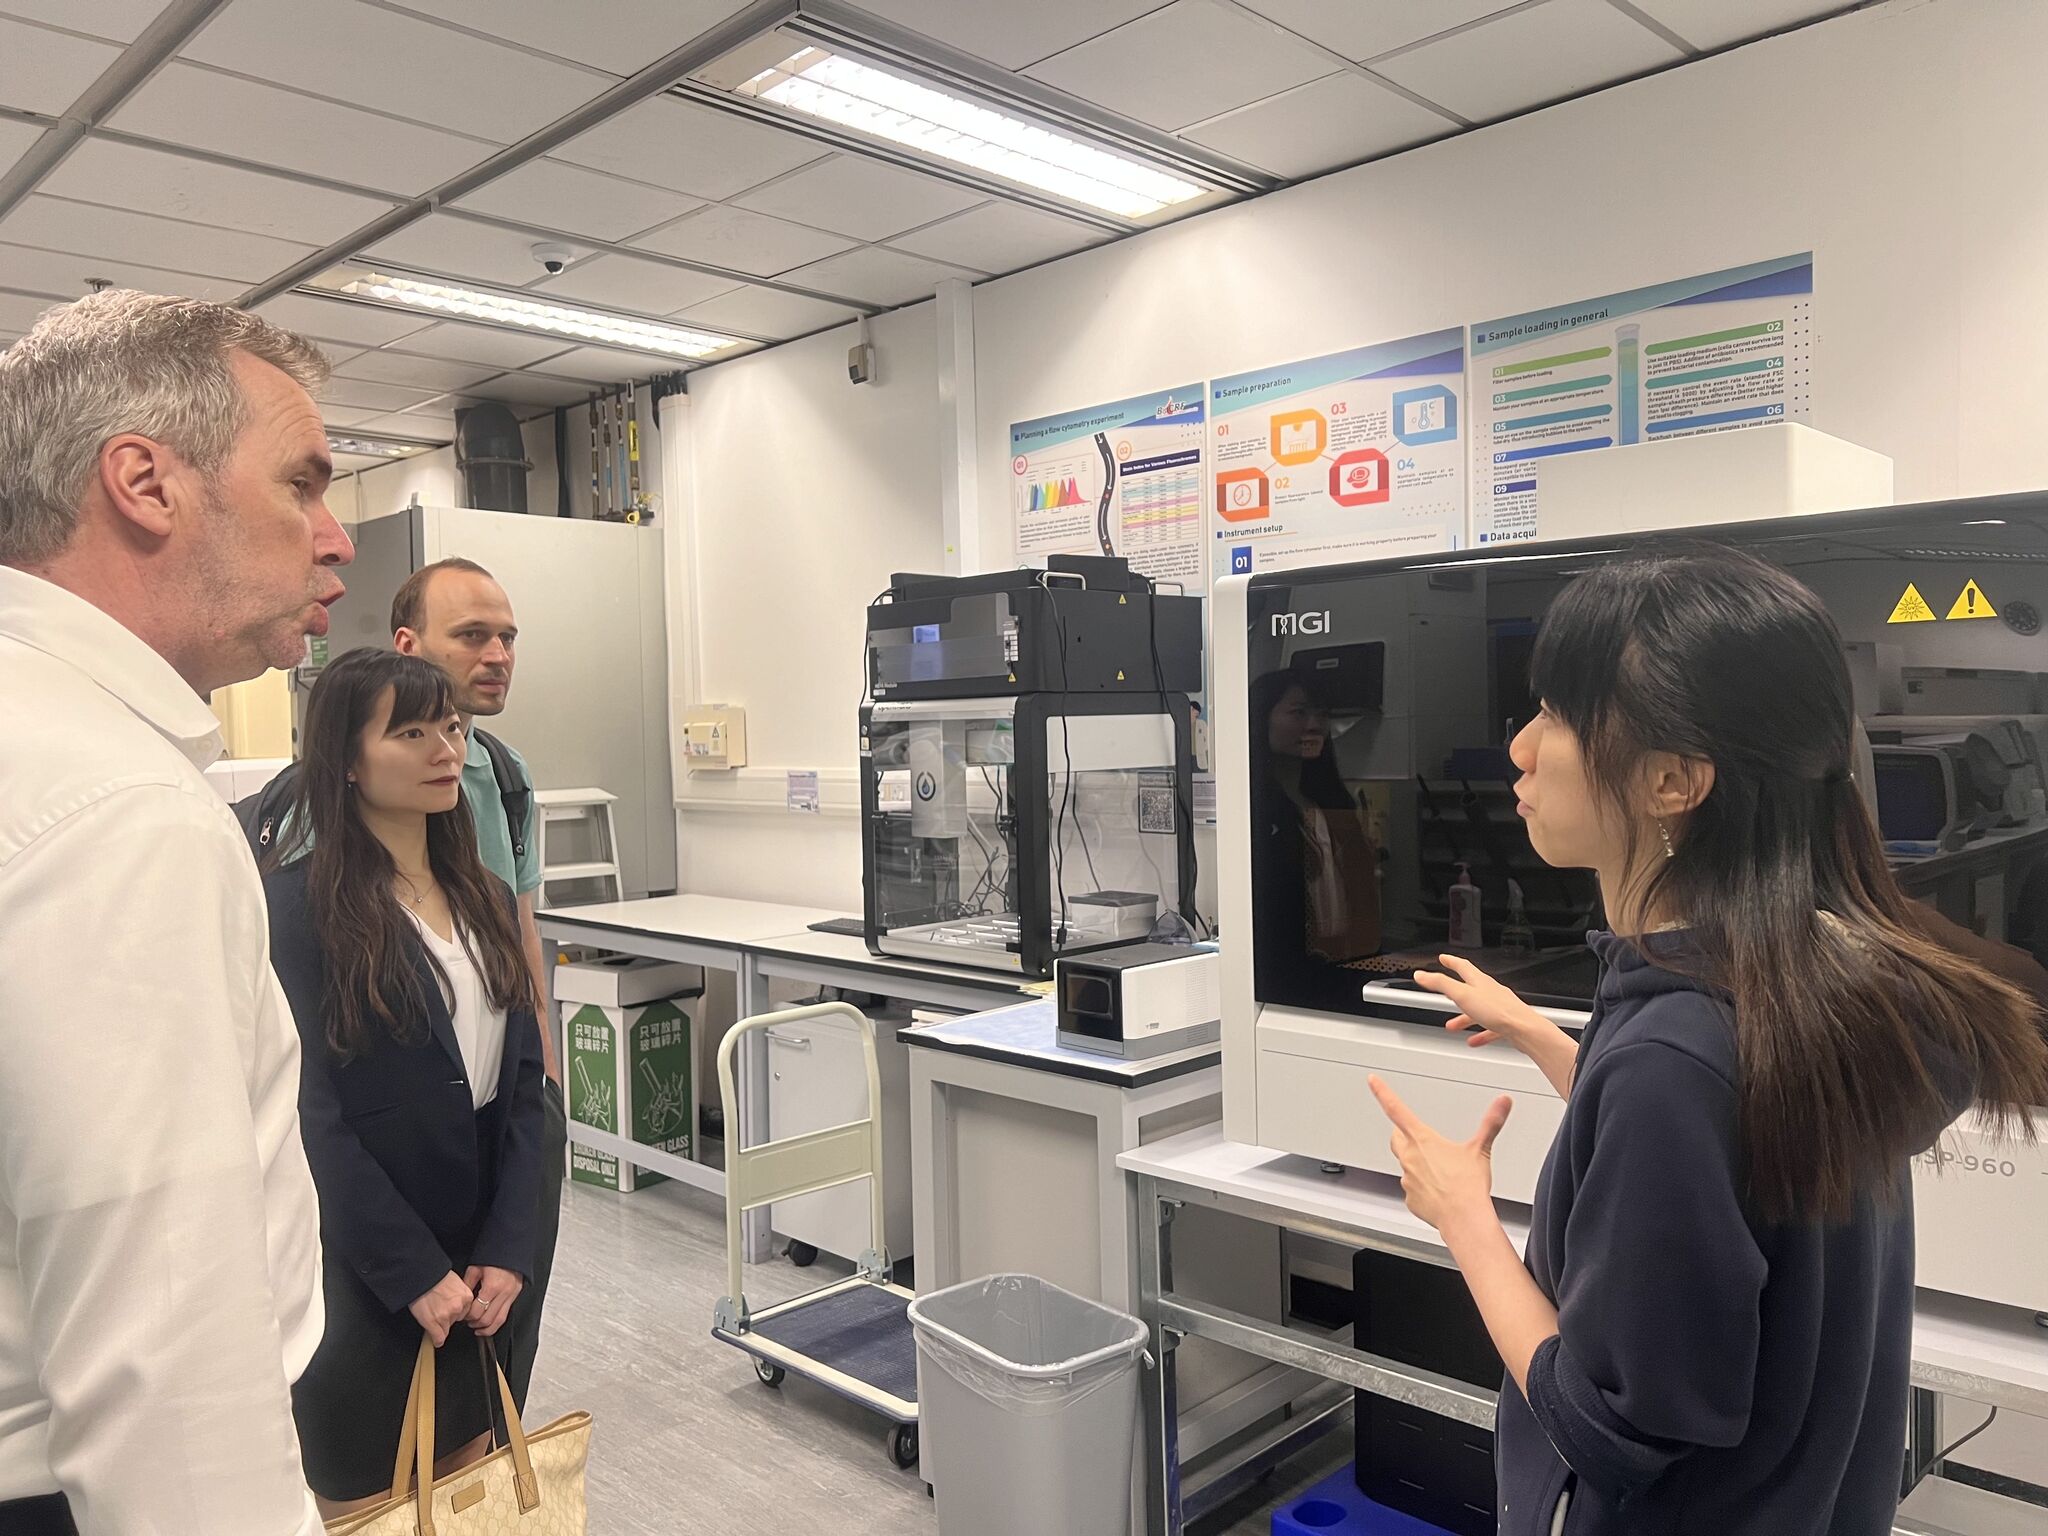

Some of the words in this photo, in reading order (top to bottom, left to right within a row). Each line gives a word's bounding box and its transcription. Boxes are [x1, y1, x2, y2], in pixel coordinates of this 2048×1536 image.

[1489, 328, 1522, 340] Sample
[1525, 321, 1558, 333] loading
[1560, 318, 1568, 326] in
[1571, 309, 1608, 326] general
[1767, 322, 1781, 332] 02
[1733, 341, 1750, 349] cannot
[1745, 341, 1784, 352] recommended
[1766, 360, 1782, 368] 04
[1494, 368, 1504, 376] 01
[1223, 386, 1249, 397] Sample
[1250, 379, 1291, 394] preparation
[1494, 394, 1506, 403] 03
[1331, 403, 1347, 416] 03
[1767, 406, 1782, 415] 06
[1020, 430, 1044, 440] Planning
[1049, 426, 1060, 434] flow
[1061, 421, 1090, 432] cytometry
[1090, 412, 1125, 425] experiment
[1217, 424, 1229, 436] 01
[1494, 423, 1506, 431] 05
[1120, 446, 1128, 454] 02
[1495, 454, 1506, 462] 07
[1016, 461, 1024, 469] 01
[1397, 458, 1415, 471] 04
[1274, 478, 1290, 490] 02
[1495, 485, 1507, 494] 09
[1224, 527, 1262, 538] Instrument
[1263, 525, 1283, 533] setup
[1490, 532, 1510, 541] Data
[1235, 557, 1248, 568] 01
[1271, 610, 1330, 637] MGI
[576, 1023, 609, 1041] 只可放置
[640, 1018, 682, 1040] 只可放置
[575, 1036, 609, 1054] 玻璃碎片
[640, 1032, 682, 1051] 玻璃碎片
[667, 1134, 689, 1153] GLASS
[573, 1155, 600, 1173] DISPOSAL
